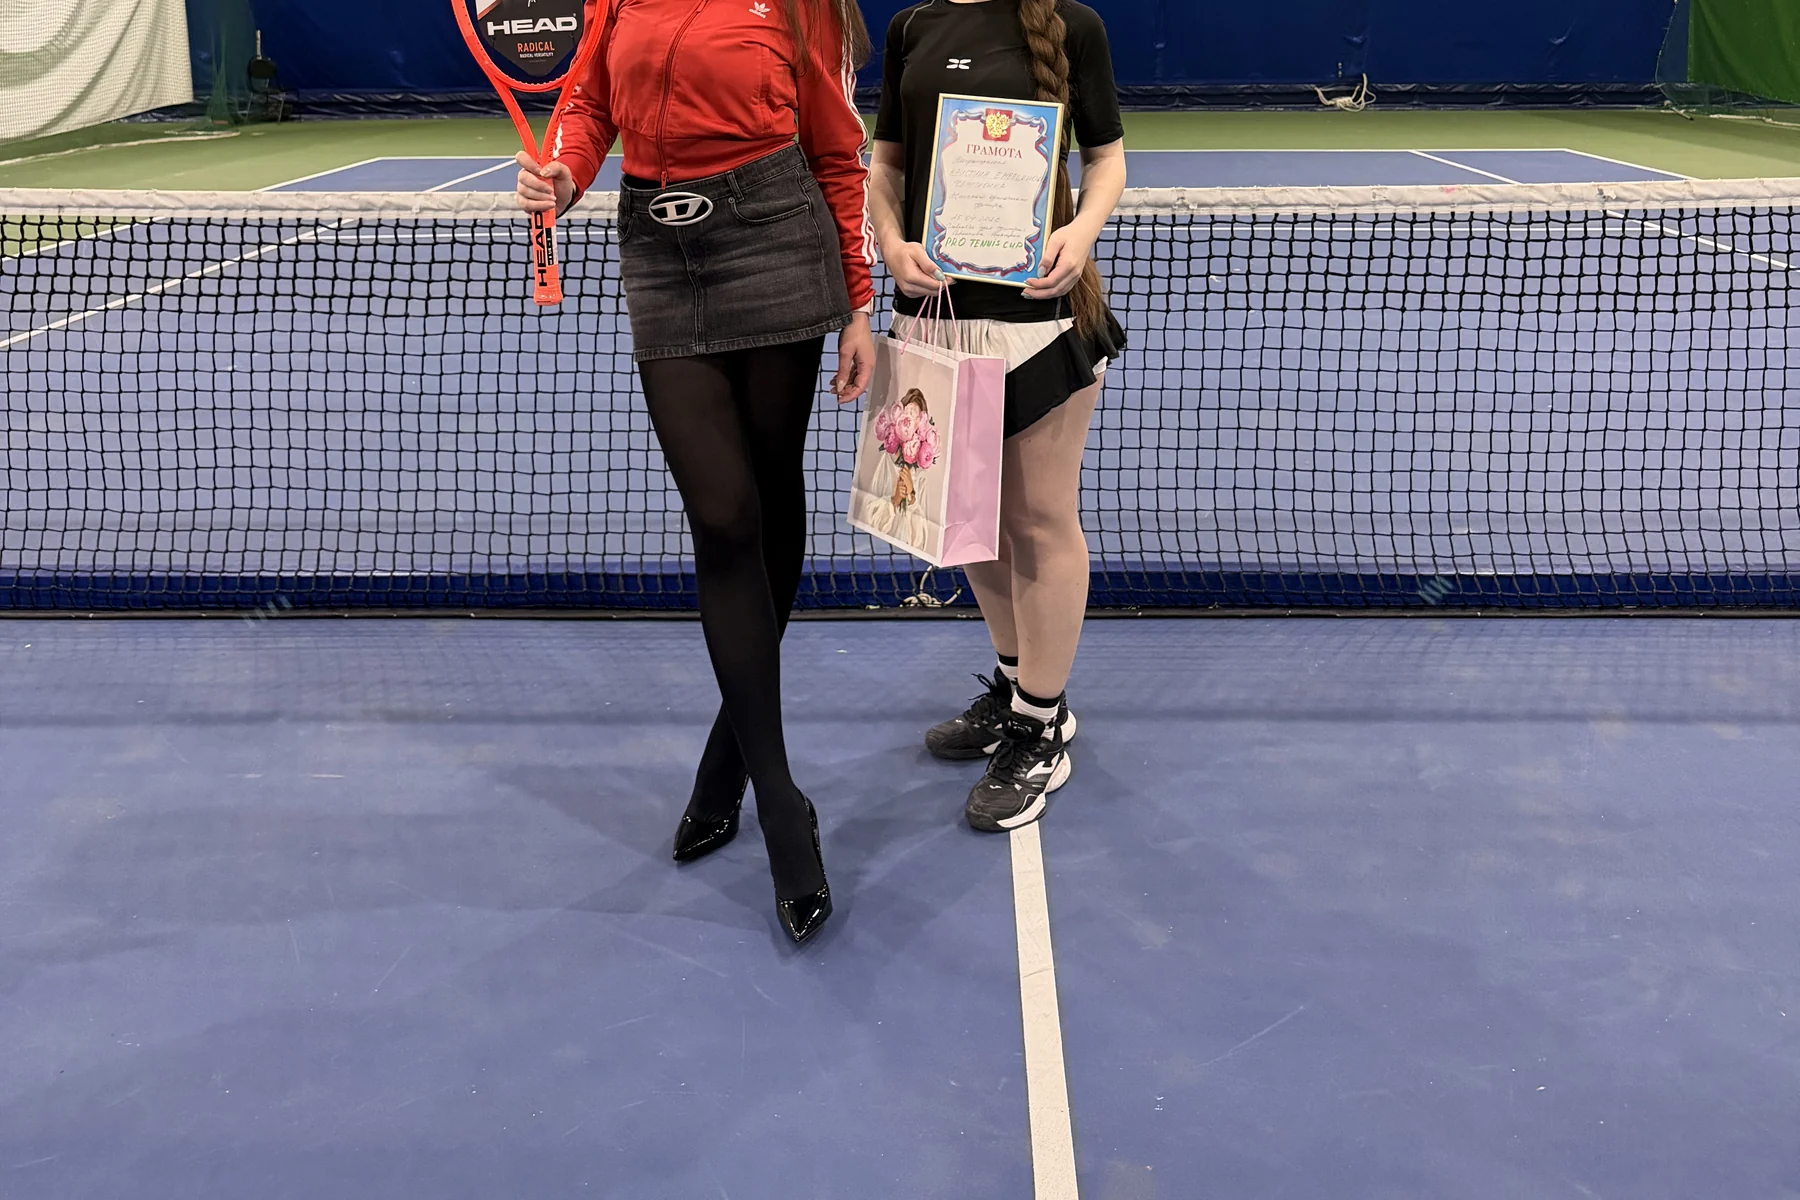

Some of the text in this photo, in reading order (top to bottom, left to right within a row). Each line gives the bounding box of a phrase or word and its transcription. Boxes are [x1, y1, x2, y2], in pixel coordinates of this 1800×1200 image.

[486, 16, 578, 37] HEAD
[517, 40, 556, 53] RADICAL
[966, 143, 1023, 159] ГРАМОТА
[533, 210, 548, 287] HEAD
[945, 237, 967, 248] PRO
